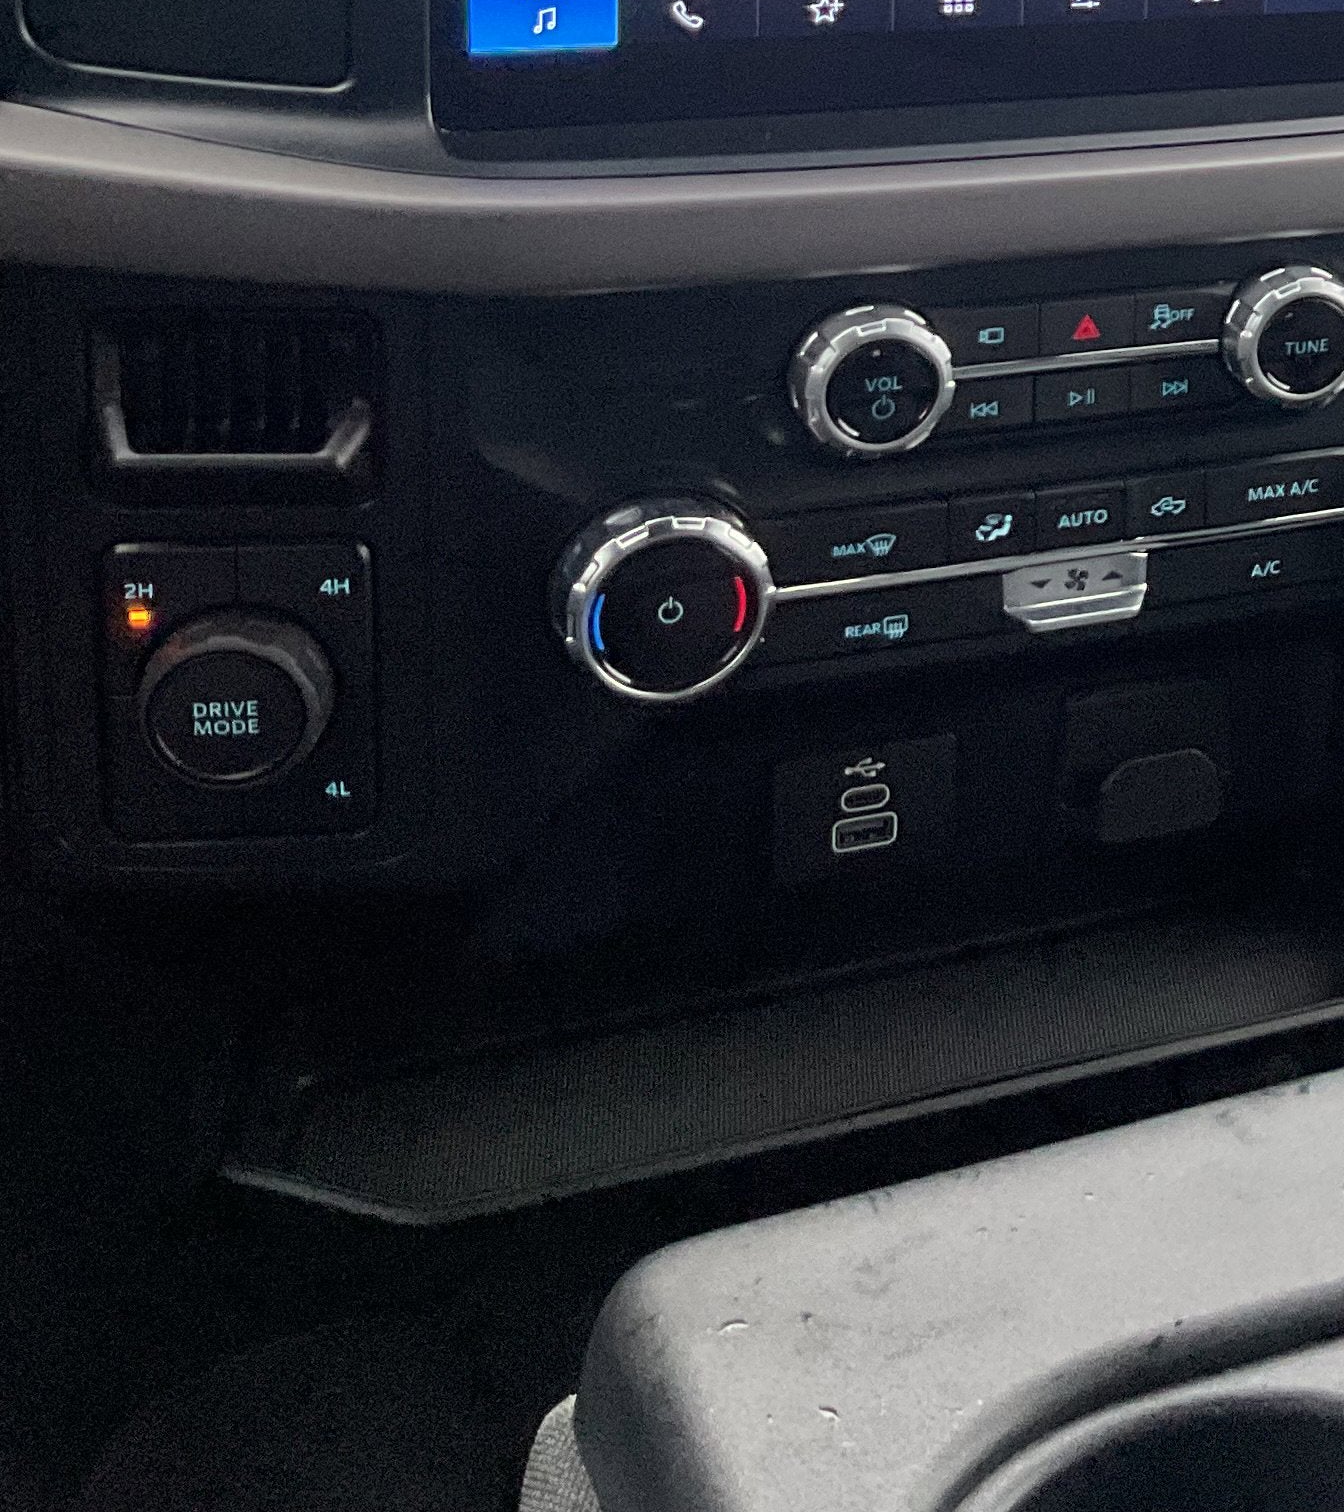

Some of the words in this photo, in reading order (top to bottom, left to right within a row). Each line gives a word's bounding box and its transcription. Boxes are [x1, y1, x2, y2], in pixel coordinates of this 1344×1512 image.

[1169, 307, 1194, 323] OFF
[1285, 338, 1329, 356] TUNE
[865, 376, 903, 393] VOL
[1248, 482, 1286, 501] MAX
[1289, 478, 1319, 497] A/C
[1058, 509, 1108, 530] AUTO
[832, 540, 866, 558] MAX
[1251, 559, 1281, 579] A/C
[124, 583, 153, 600] 2H
[320, 578, 350, 596] 4H
[845, 621, 881, 640] REAR
[192, 700, 259, 718] DRIVE
[193, 718, 259, 737] MODE
[325, 780, 351, 798] 4L
